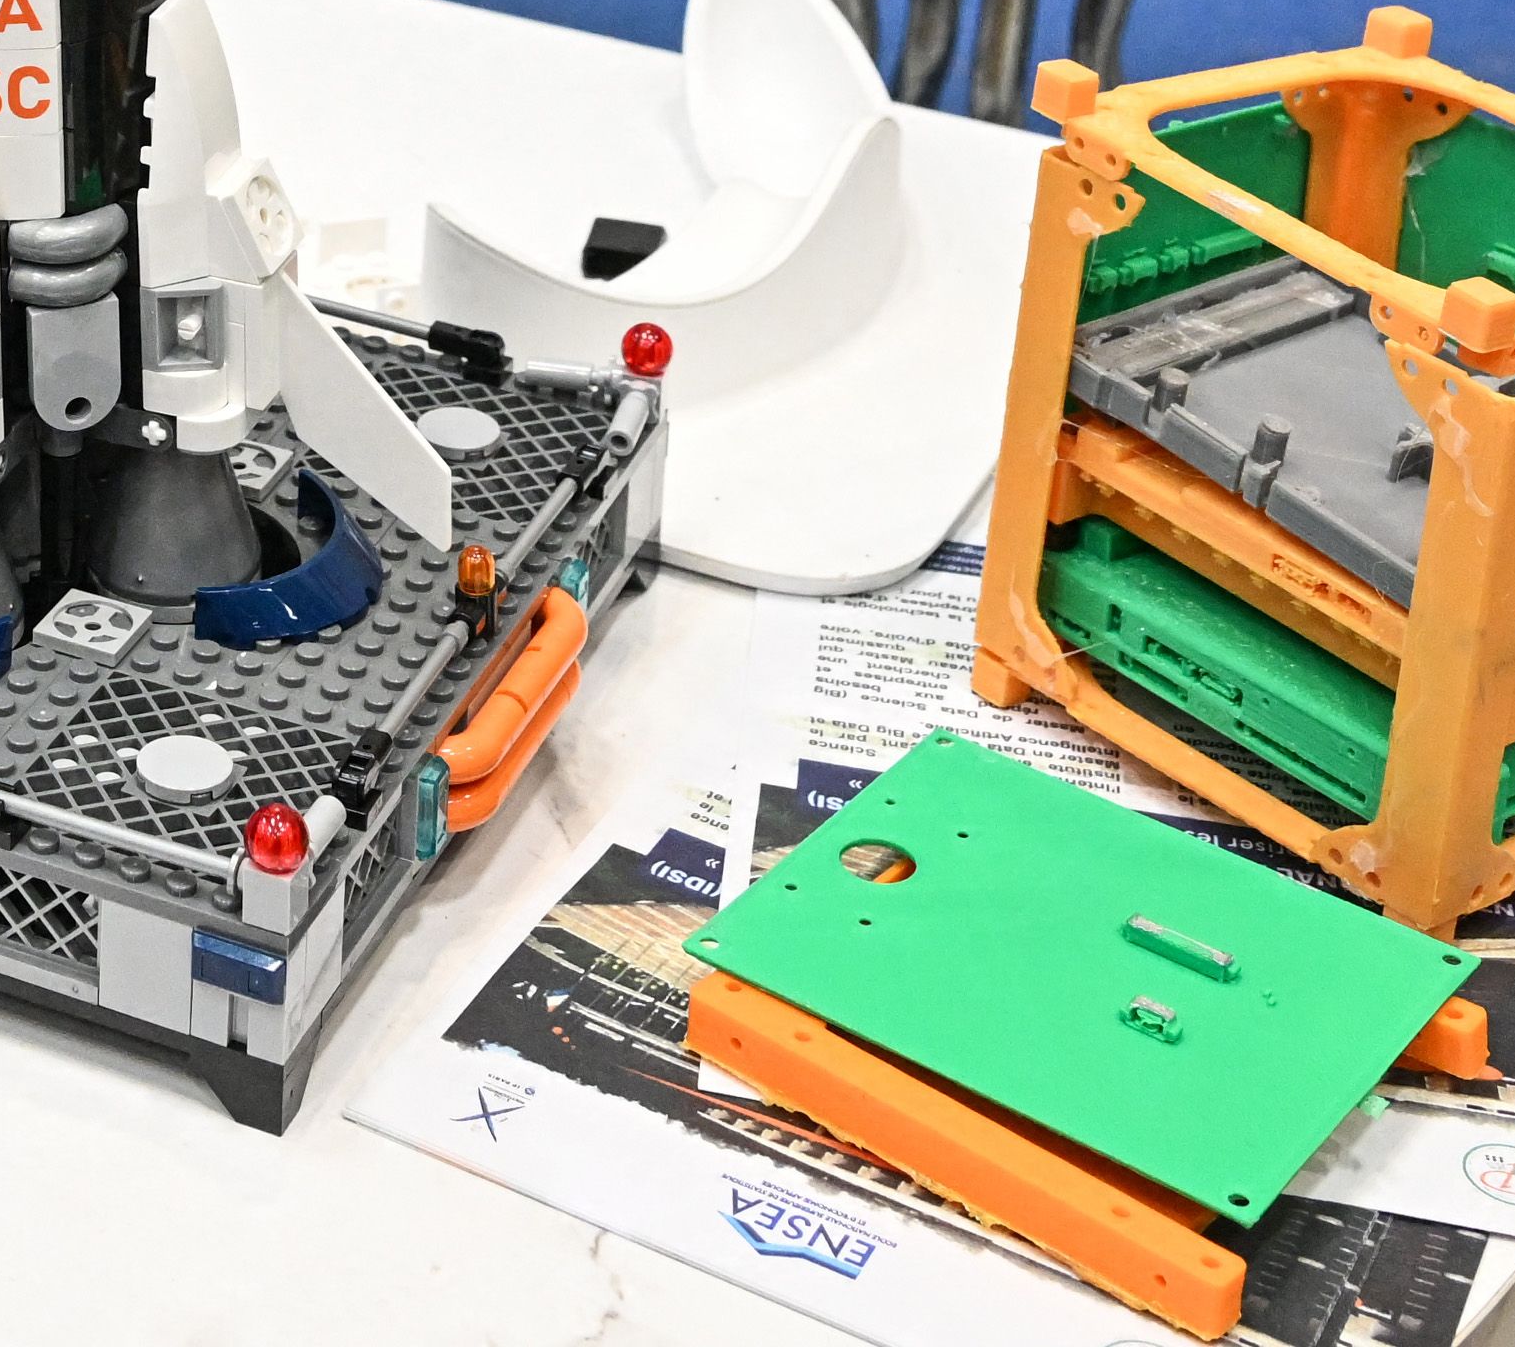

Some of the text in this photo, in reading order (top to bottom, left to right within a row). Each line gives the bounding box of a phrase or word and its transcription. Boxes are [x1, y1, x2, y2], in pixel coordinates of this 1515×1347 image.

[820, 624, 860, 634] voire
[818, 644, 844, 653] qui
[820, 635, 905, 651] quasiment
[857, 650, 913, 665] Master
[818, 655, 950, 679] cherchent une
[816, 677, 881, 693] besoins
[817, 666, 948, 690] entreprises et
[915, 692, 944, 701] aux
[814, 686, 1085, 734] Master de Data Science (Big
[810, 717, 825, 725] et
[832, 720, 870, 733] Data
[810, 728, 824, 737] le
[839, 733, 867, 743] par
[877, 725, 904, 737] Big
[809, 739, 877, 757] Science
[987, 743, 1025, 756] Data
[1019, 737, 1120, 758] Intelligence
[1033, 750, 1053, 759] en
[1061, 754, 1120, 770] Master
[1049, 764, 1120, 781] Institute
[690, 813, 729, 832] ence
[650, 860, 720, 898] (IDSI)
[732, 1188, 876, 1268] ENSEA
